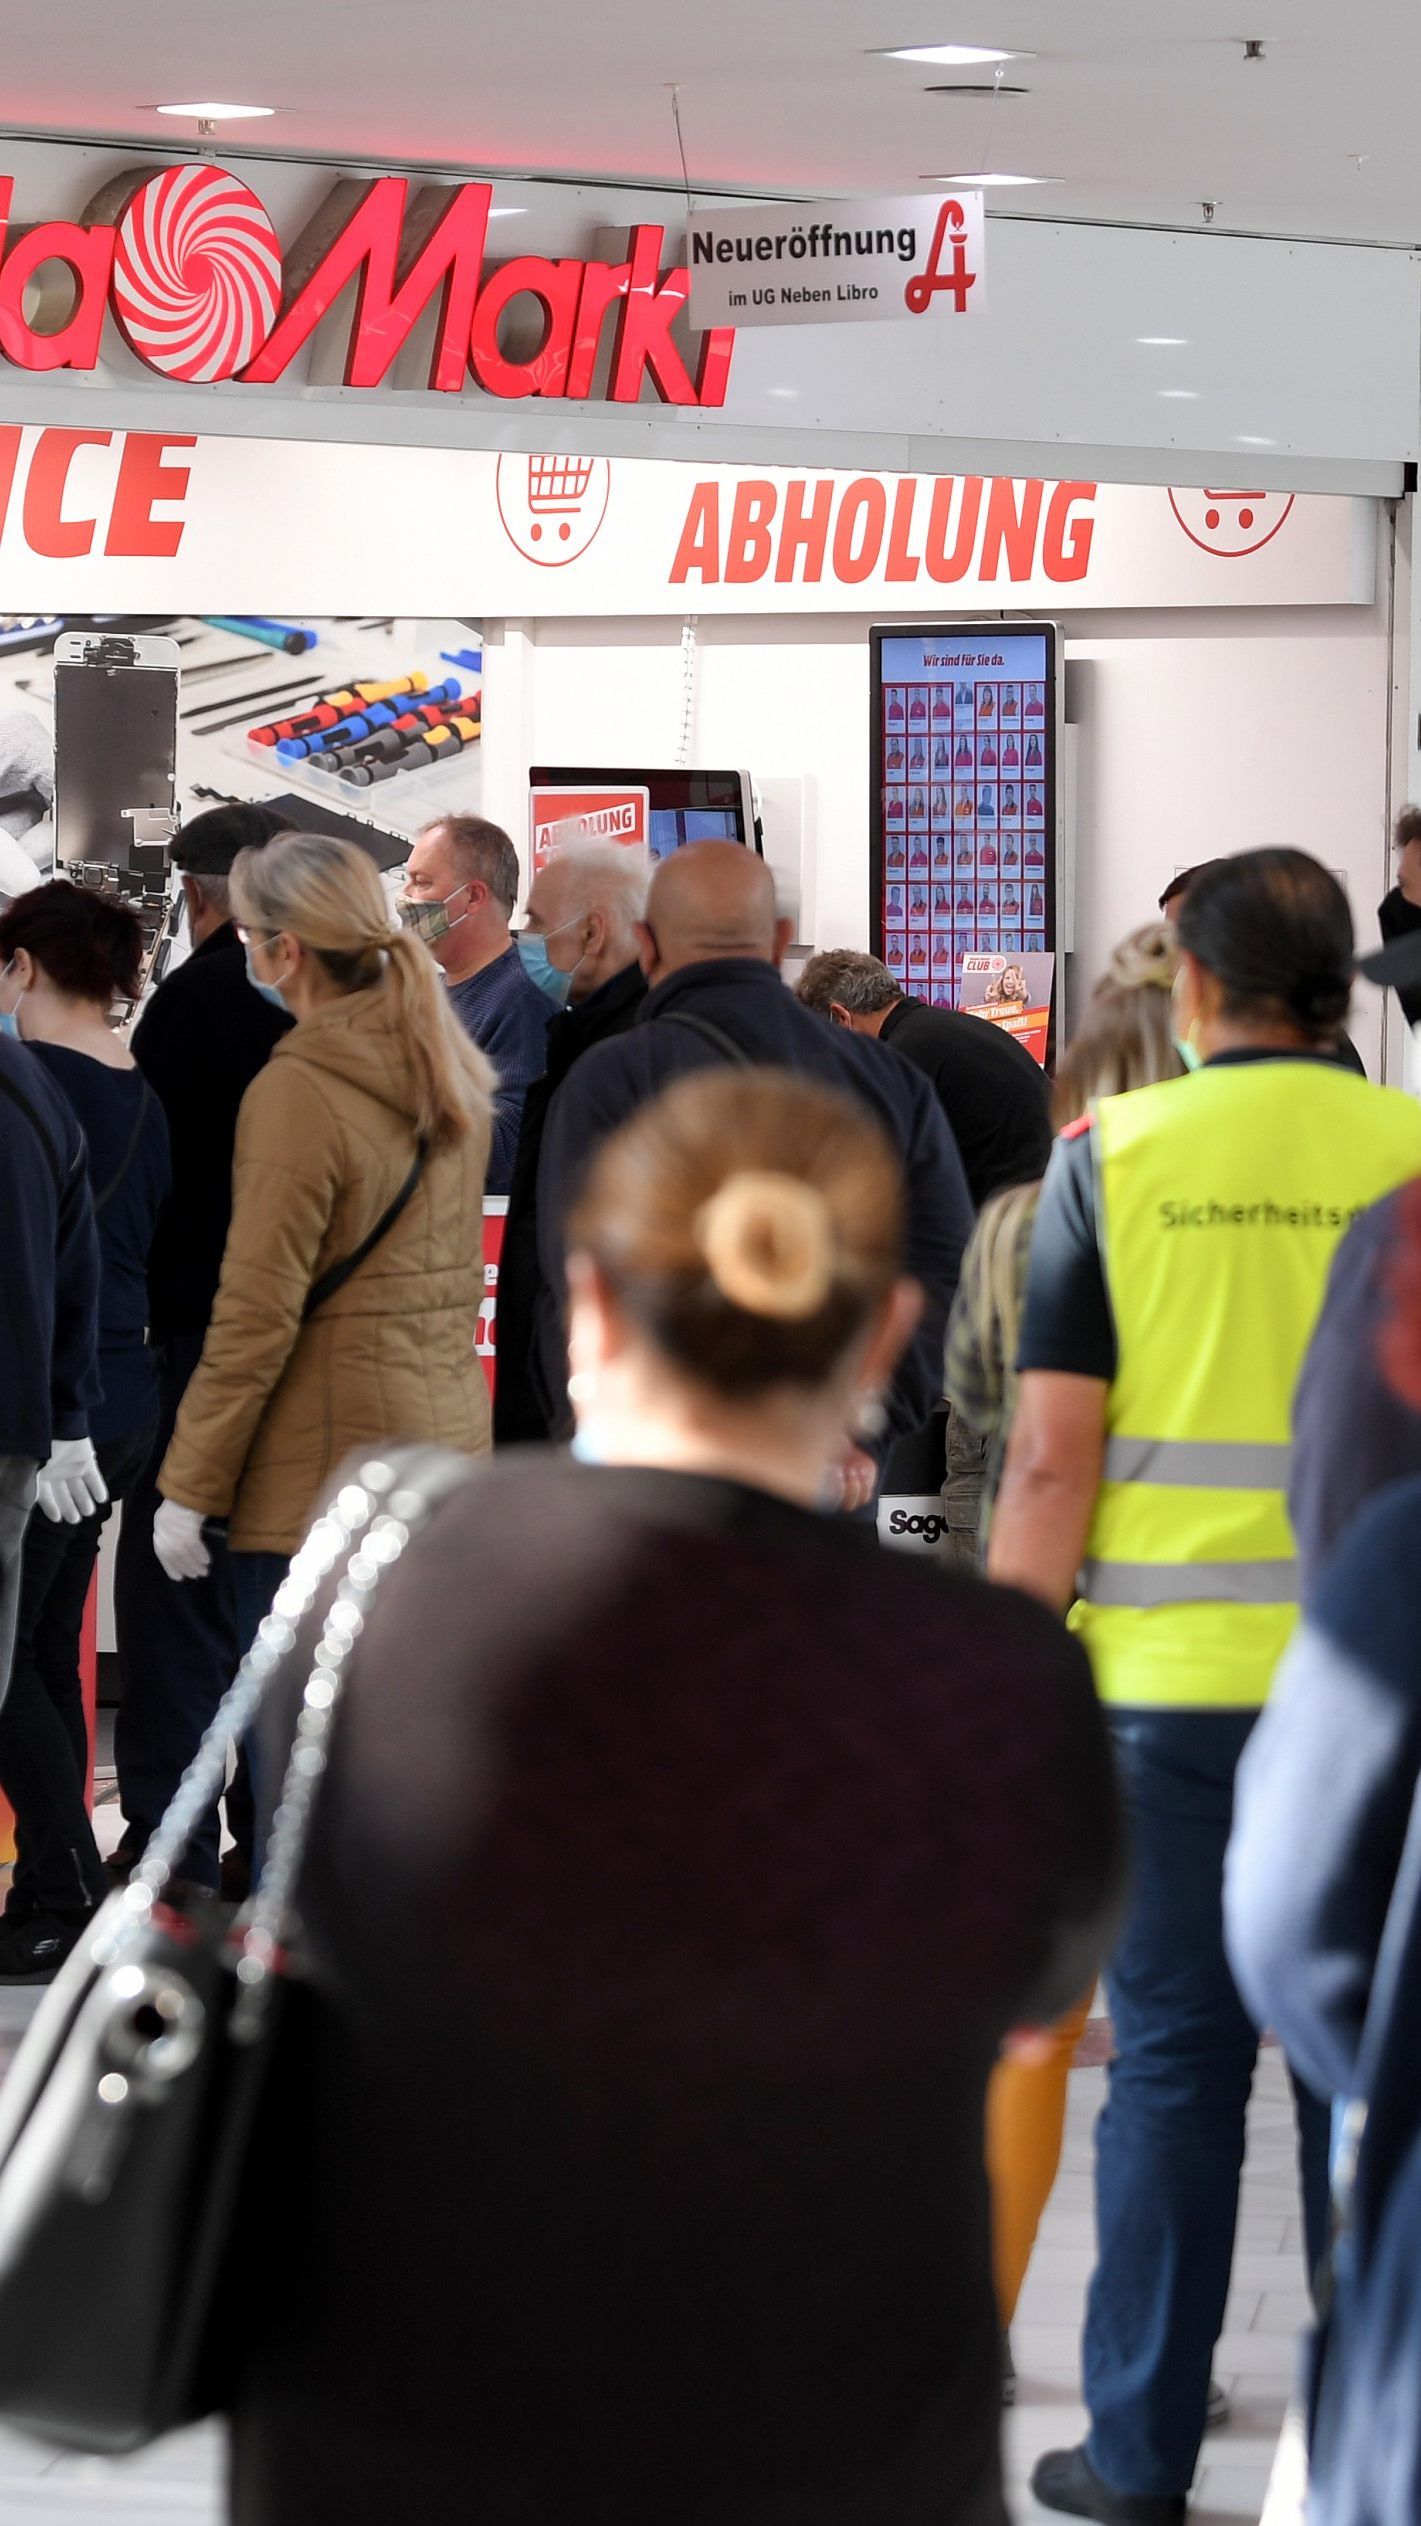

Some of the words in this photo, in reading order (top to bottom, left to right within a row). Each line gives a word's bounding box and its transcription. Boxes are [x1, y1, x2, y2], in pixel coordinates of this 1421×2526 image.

[691, 224, 917, 265] Neueröffnung
[728, 290, 747, 306] im
[752, 288, 775, 305] UG
[781, 286, 831, 303] Neben
[837, 285, 878, 301] Libro
[0, 426, 198, 558] CE
[668, 476, 1098, 584] ABHOLUNG
[923, 654, 940, 667] Wir
[941, 654, 960, 666] sind
[961, 654, 976, 666] für
[976, 653, 990, 666] Sie
[991, 653, 1005, 666] da.
[967, 961, 991, 971] CLUB
